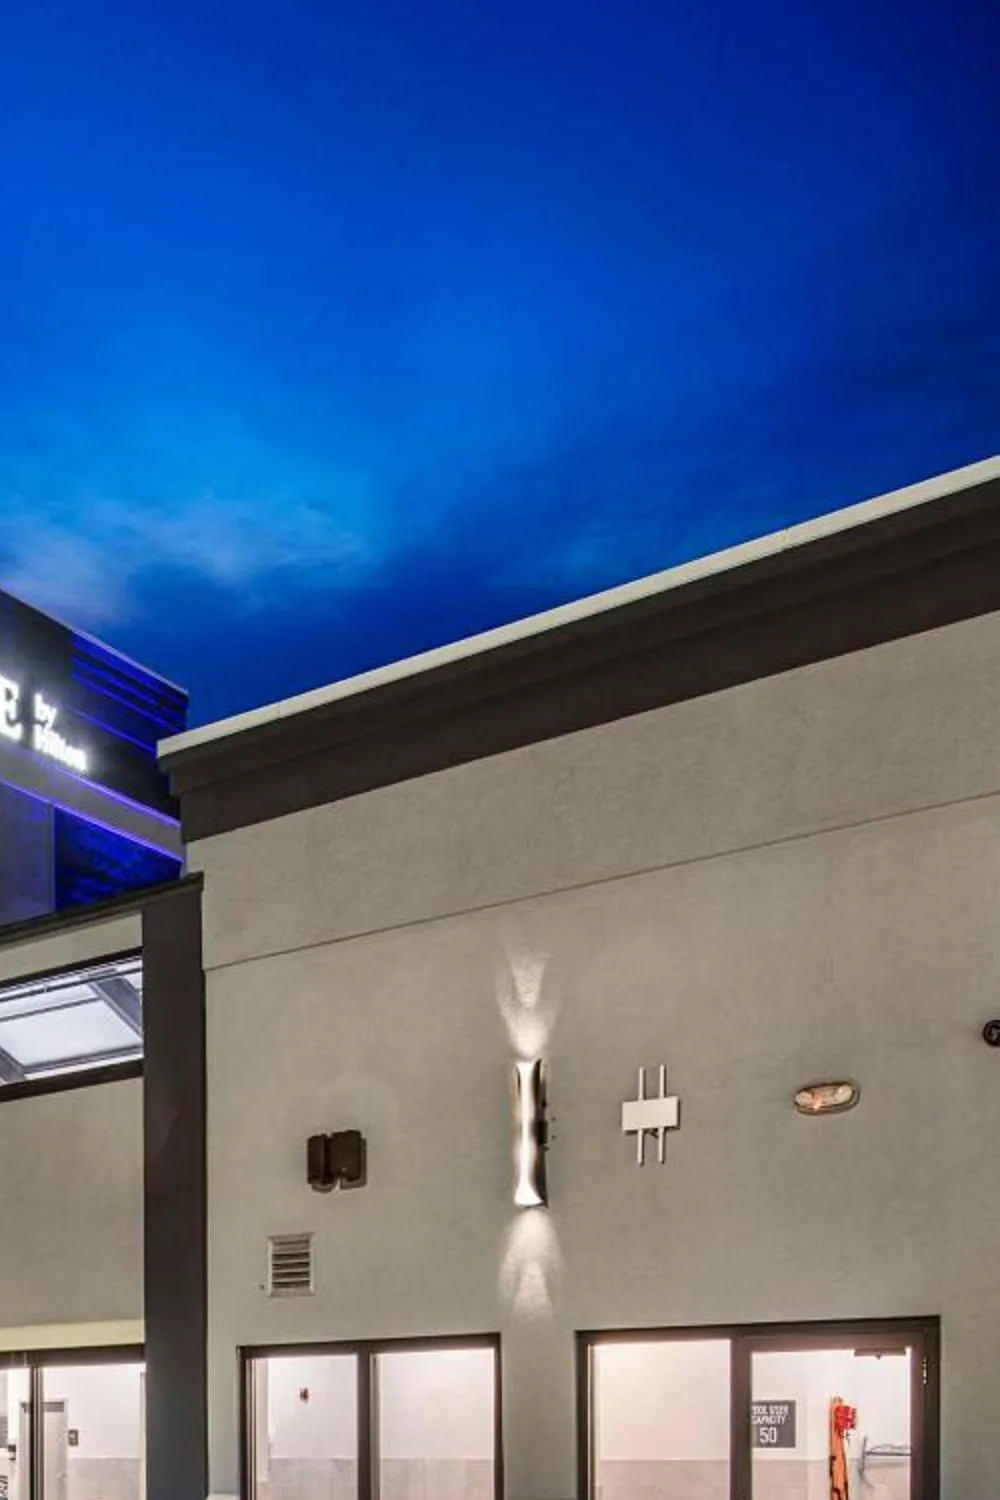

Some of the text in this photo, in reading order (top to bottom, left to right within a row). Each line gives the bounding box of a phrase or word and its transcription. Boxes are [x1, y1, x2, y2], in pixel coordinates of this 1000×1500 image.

[33, 693, 57, 731] by
[33, 723, 87, 772] Hilton
[759, 1427, 777, 1443] 50
